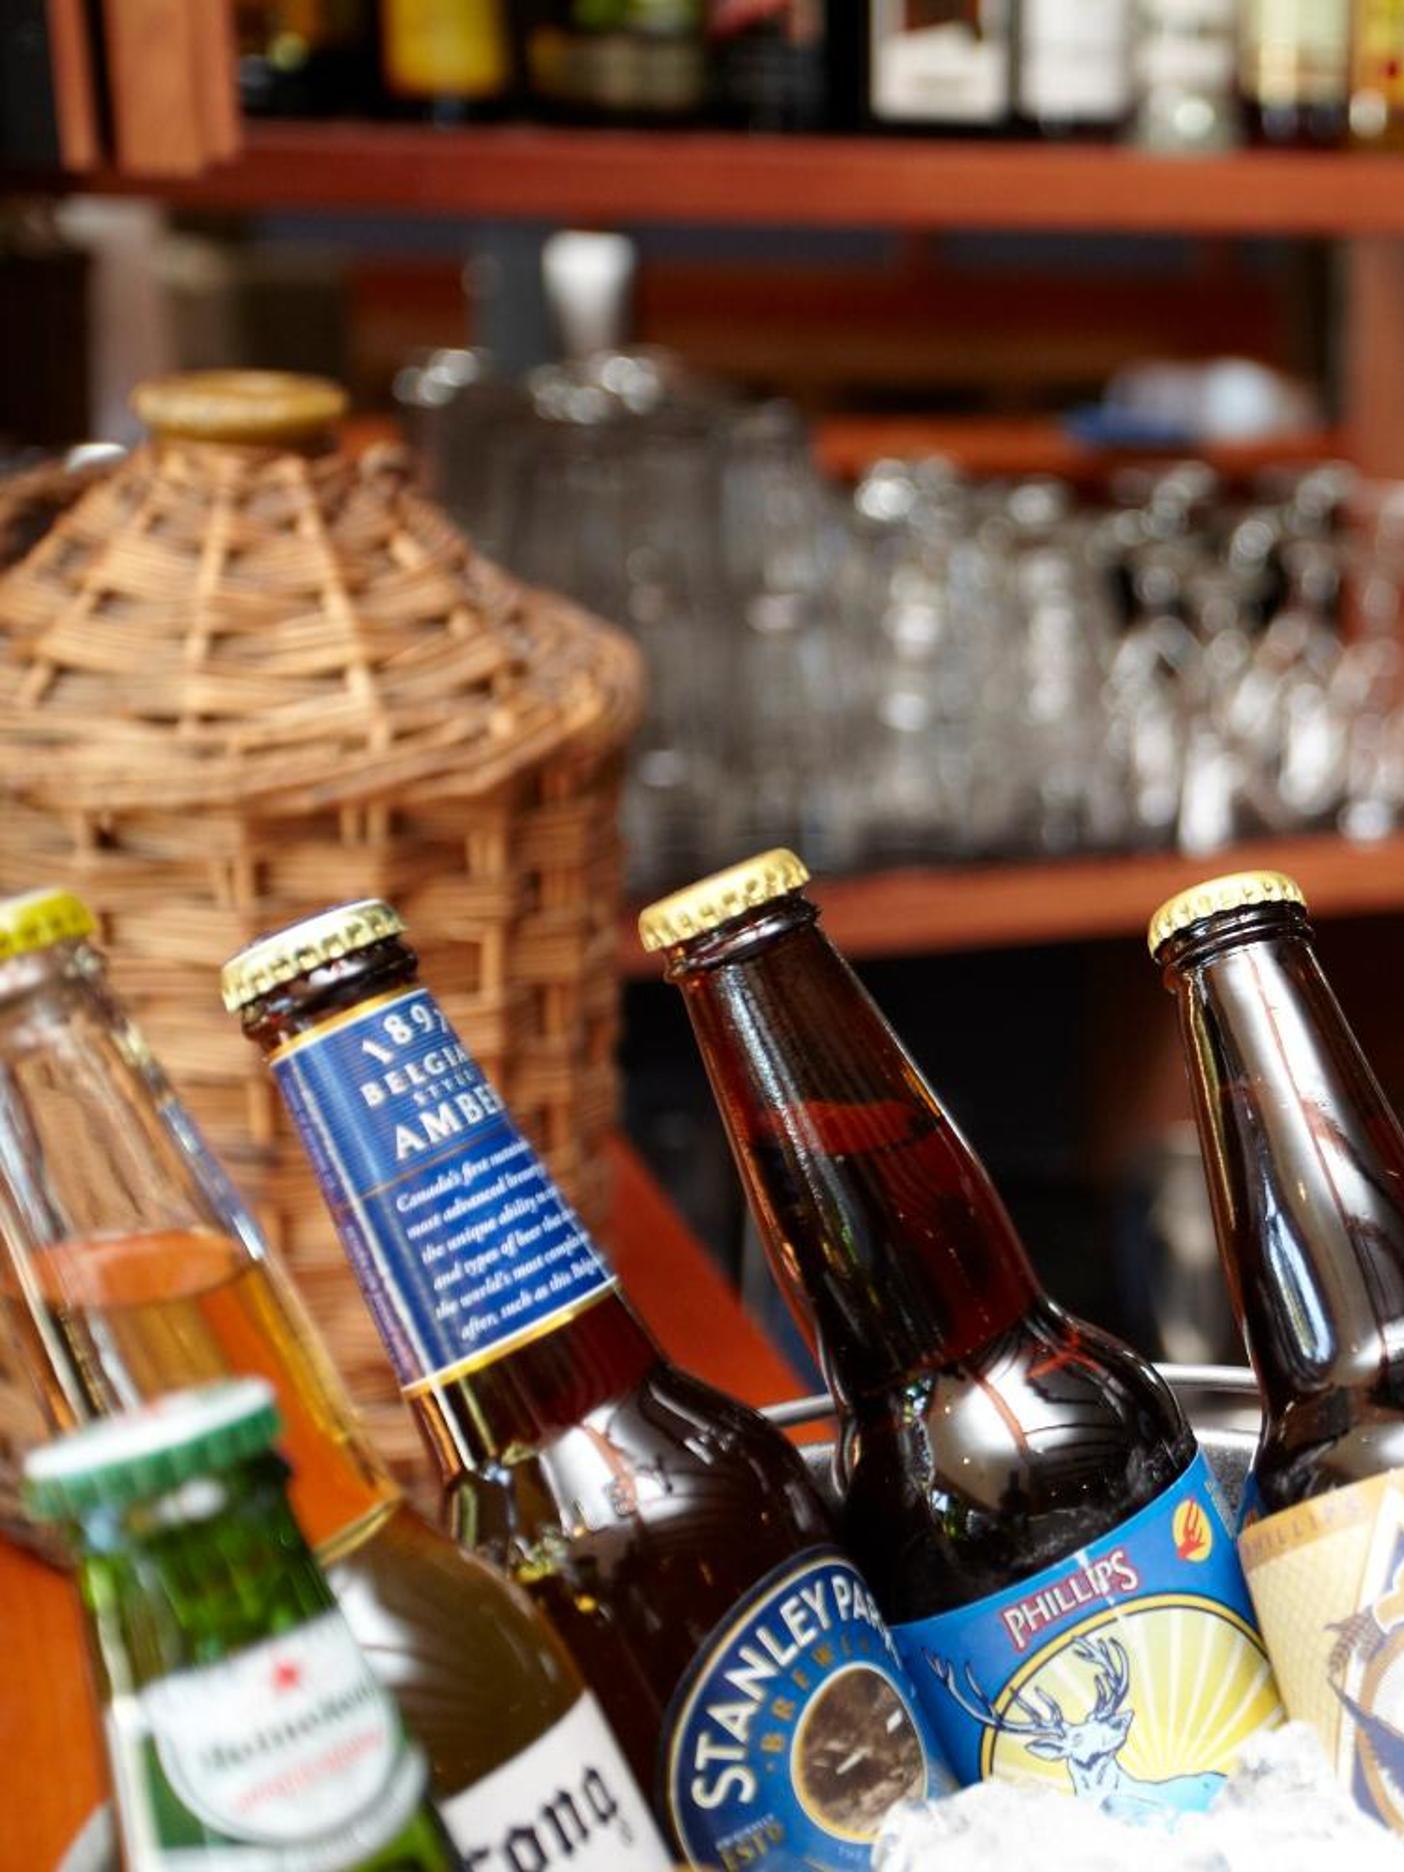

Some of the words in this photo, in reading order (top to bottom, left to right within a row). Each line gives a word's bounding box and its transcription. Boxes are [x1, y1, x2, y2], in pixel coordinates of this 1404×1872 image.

[360, 1043, 470, 1107] BELGIA
[407, 1214, 443, 1240] most
[443, 1176, 507, 1223] advanced
[421, 1242, 446, 1265] the
[446, 1218, 497, 1251] unique
[434, 1261, 463, 1291] and
[464, 1249, 500, 1277] types
[501, 1233, 518, 1258] of
[435, 1300, 460, 1321] the
[513, 1255, 545, 1281] most
[501, 1289, 533, 1319] such
[1000, 1549, 1141, 1651] PHILLIPS
[691, 1580, 832, 1809] STANLEY
[831, 1574, 901, 1671] PAR
